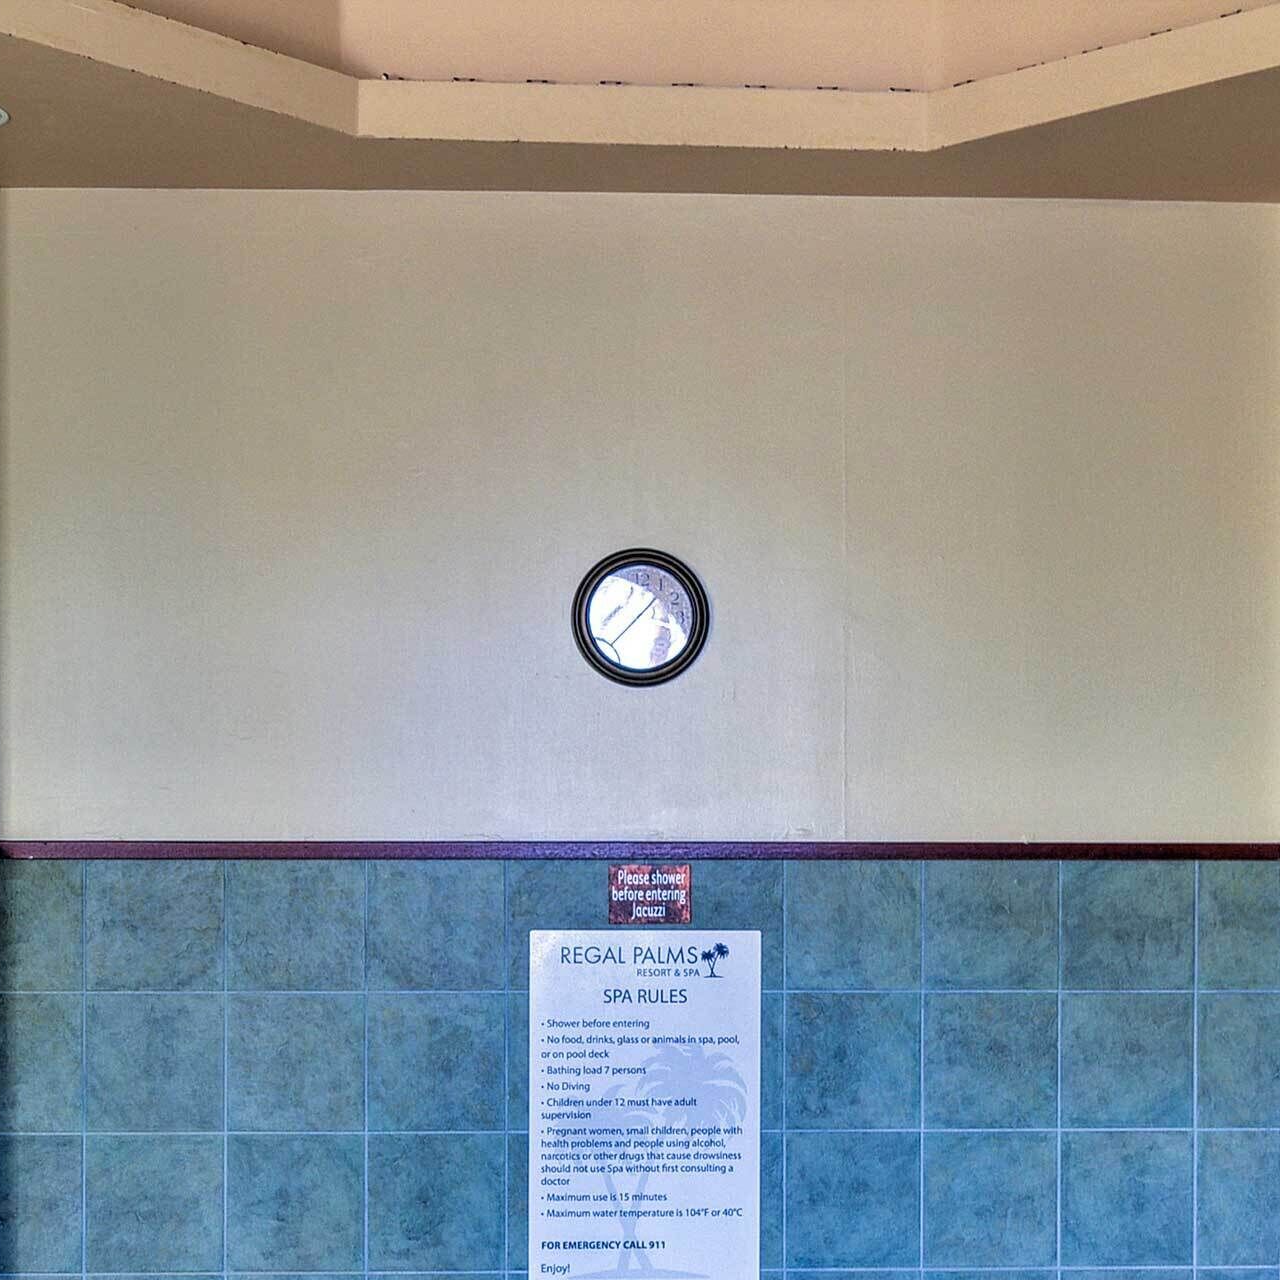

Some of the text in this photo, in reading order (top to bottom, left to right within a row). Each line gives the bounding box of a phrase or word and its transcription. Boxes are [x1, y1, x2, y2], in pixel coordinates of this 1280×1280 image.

[635, 573, 649, 586] 12
[670, 591, 680, 605] 2
[618, 870, 686, 885] Please shower
[612, 886, 686, 904] before entering
[631, 904, 666, 920] Jacuzzi
[561, 946, 698, 964] REGAL PALMS
[636, 968, 700, 977] RESORT & SPA
[603, 989, 688, 1004] SPA RULES
[547, 1018, 650, 1030] Shower before entering
[547, 1034, 740, 1046] No food, drinks, glass or animals in spa, pool,
[552, 1051, 564, 1059] on
[566, 1049, 587, 1060] pool
[588, 1049, 610, 1059] deck
[547, 1065, 646, 1077] Bathing load 7 persons
[547, 1082, 590, 1093] No Diving
[546, 1097, 697, 1107] Children under 12 must have adult
[541, 1110, 592, 1121] supervision
[547, 1126, 743, 1138] Pregnant women, small children, people with
[541, 1138, 726, 1150] health problems and people using alcohol,
[541, 1152, 581, 1161] narcotics
[582, 1153, 593, 1161] or
[593, 1151, 618, 1161] other
[618, 1151, 645, 1163] drugs
[646, 1151, 665, 1160] that
[693, 1151, 742, 1160] drowsiness
[541, 1164, 571, 1173] should
[573, 1165, 588, 1173] not
[607, 1164, 624, 1175] Spa
[625, 1163, 660, 1173] without
[662, 1163, 679, 1173] first
[680, 1163, 727, 1175] consulting
[541, 1176, 570, 1186] doctor
[546, 1192, 668, 1202] Maximum use is 15 minutes
[546, 1209, 591, 1218] Maximum
[619, 1209, 674, 1219] temperature
[676, 1208, 683, 1217] is
[541, 1240, 665, 1250] FOR EMERGENCY CALL 911
[540, 1263, 570, 1275] Enjoy!
